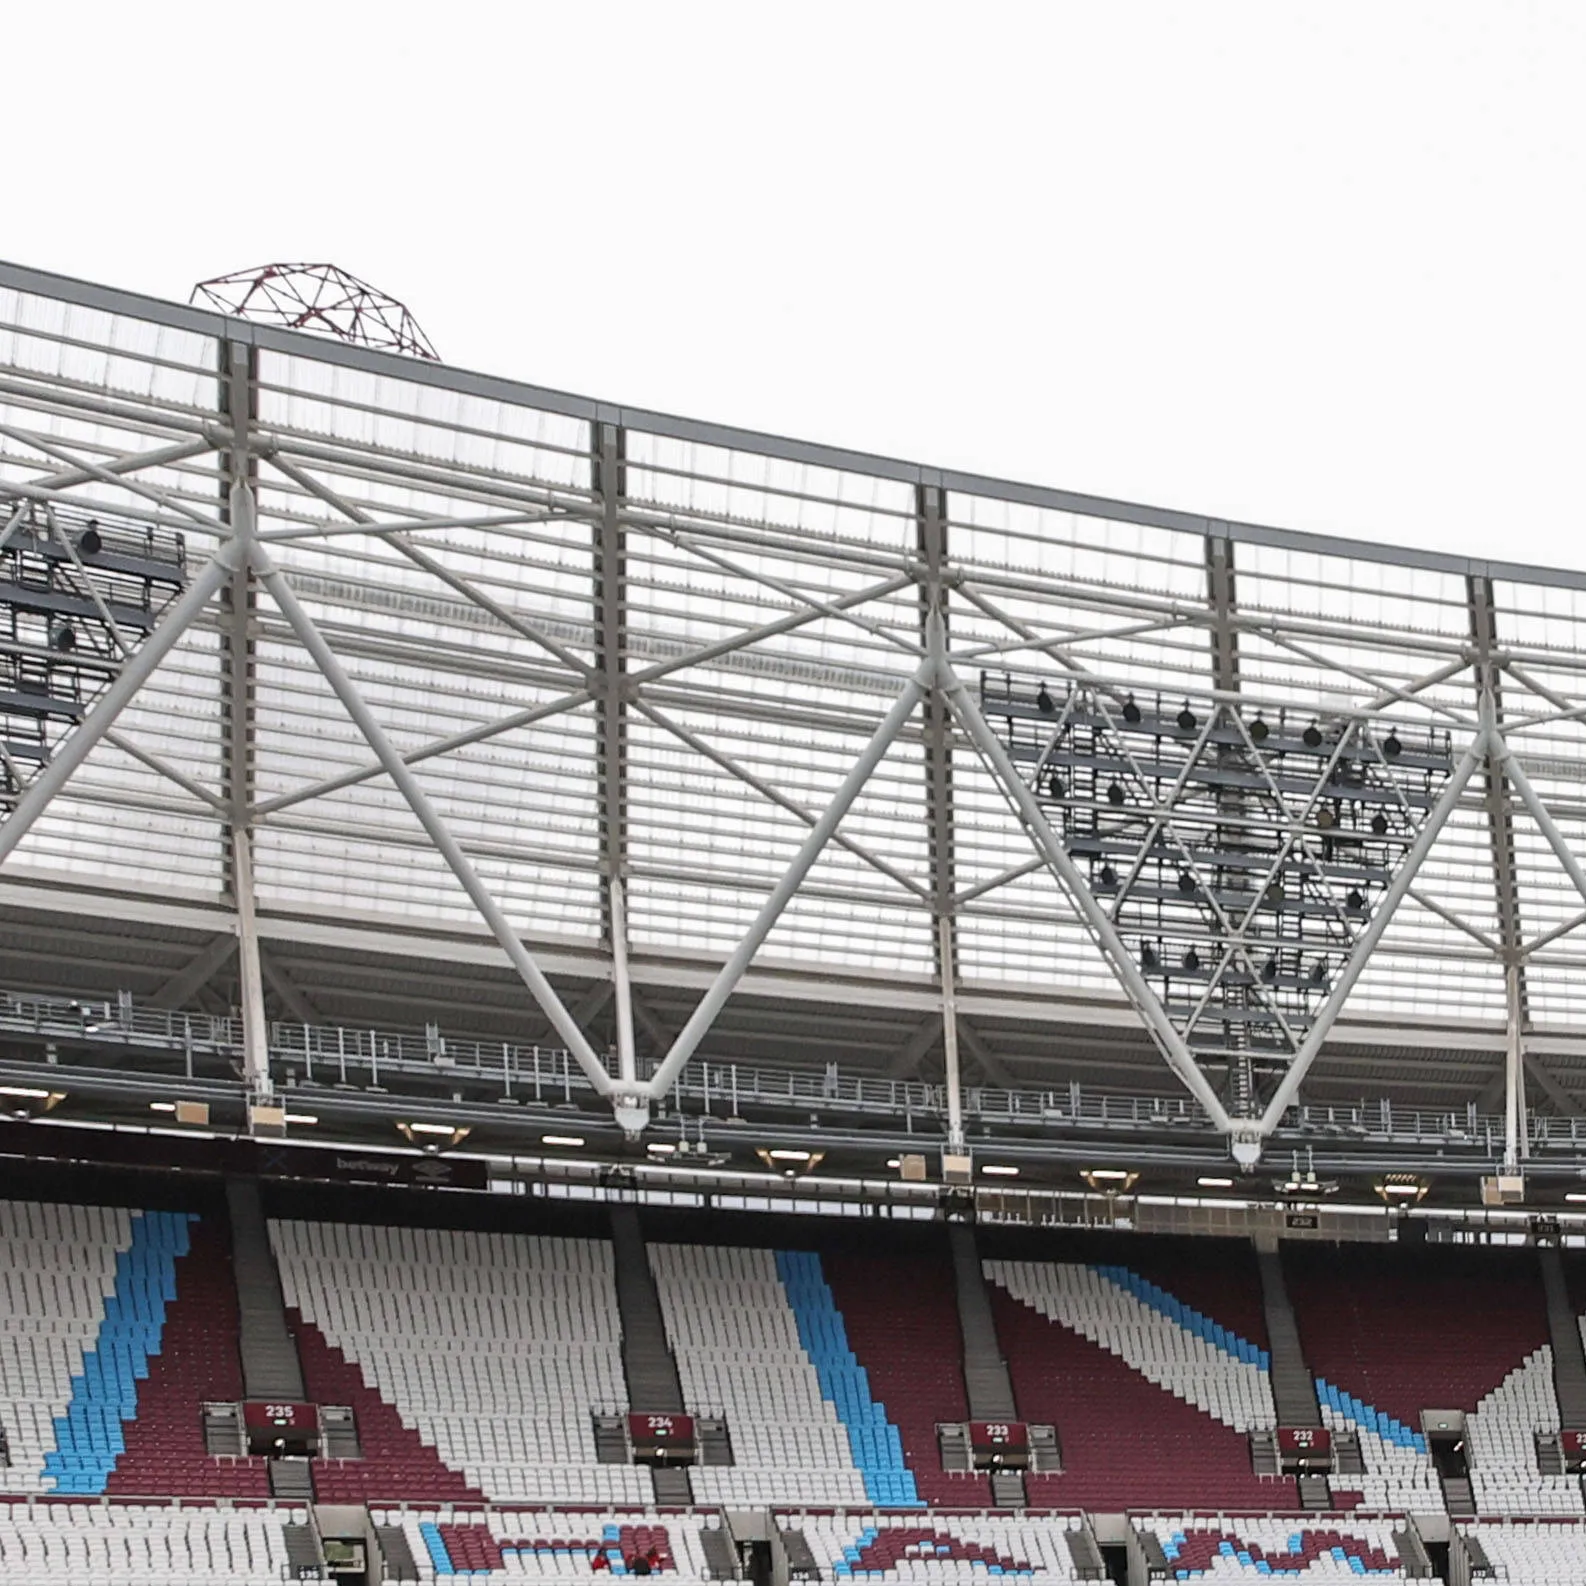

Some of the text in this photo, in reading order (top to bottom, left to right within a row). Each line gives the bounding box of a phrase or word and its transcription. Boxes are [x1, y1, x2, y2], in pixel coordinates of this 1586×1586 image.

[337, 1157, 399, 1175] betway
[265, 1405, 294, 1417] 235
[647, 1416, 673, 1428] 234
[986, 1425, 1009, 1436] 233
[1293, 1430, 1314, 1441] 232
